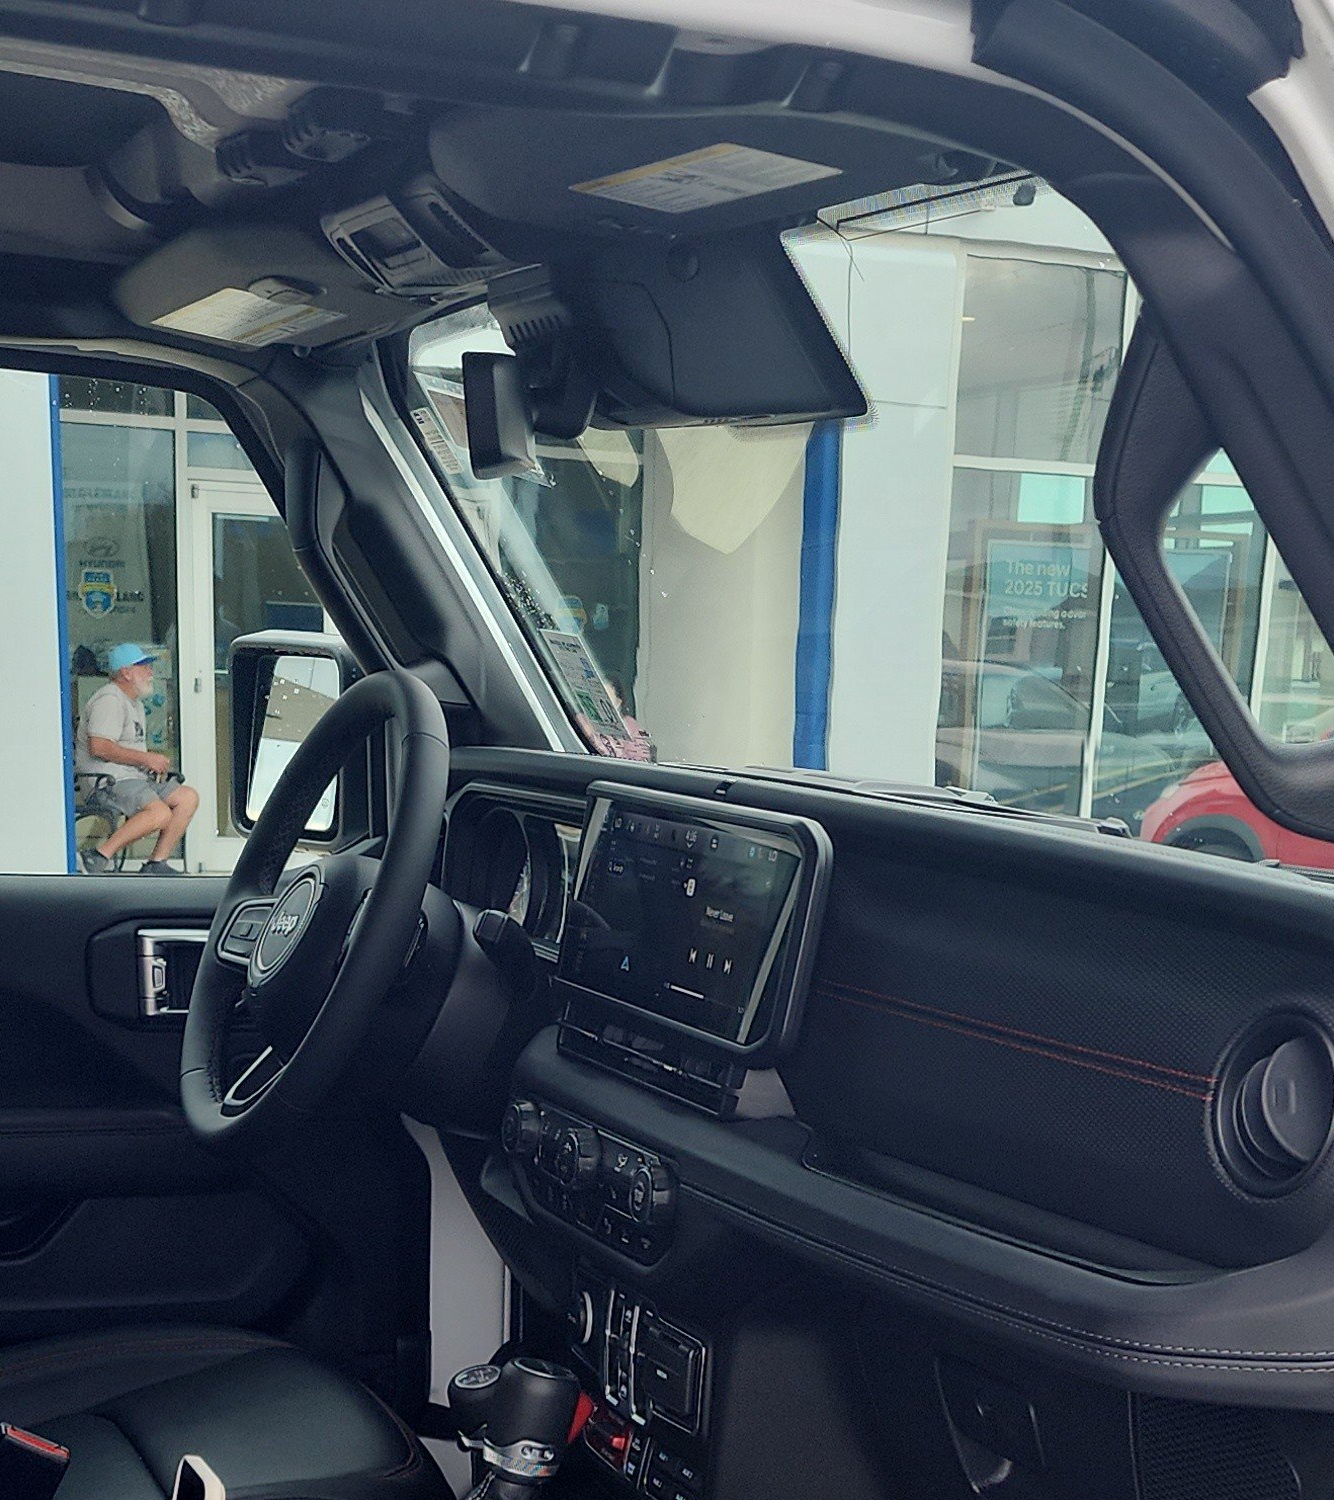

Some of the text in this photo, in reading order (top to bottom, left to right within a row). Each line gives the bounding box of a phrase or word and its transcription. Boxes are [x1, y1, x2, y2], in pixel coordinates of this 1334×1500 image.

[1007, 561, 1071, 577] The new
[1004, 579, 1043, 596] 2025
